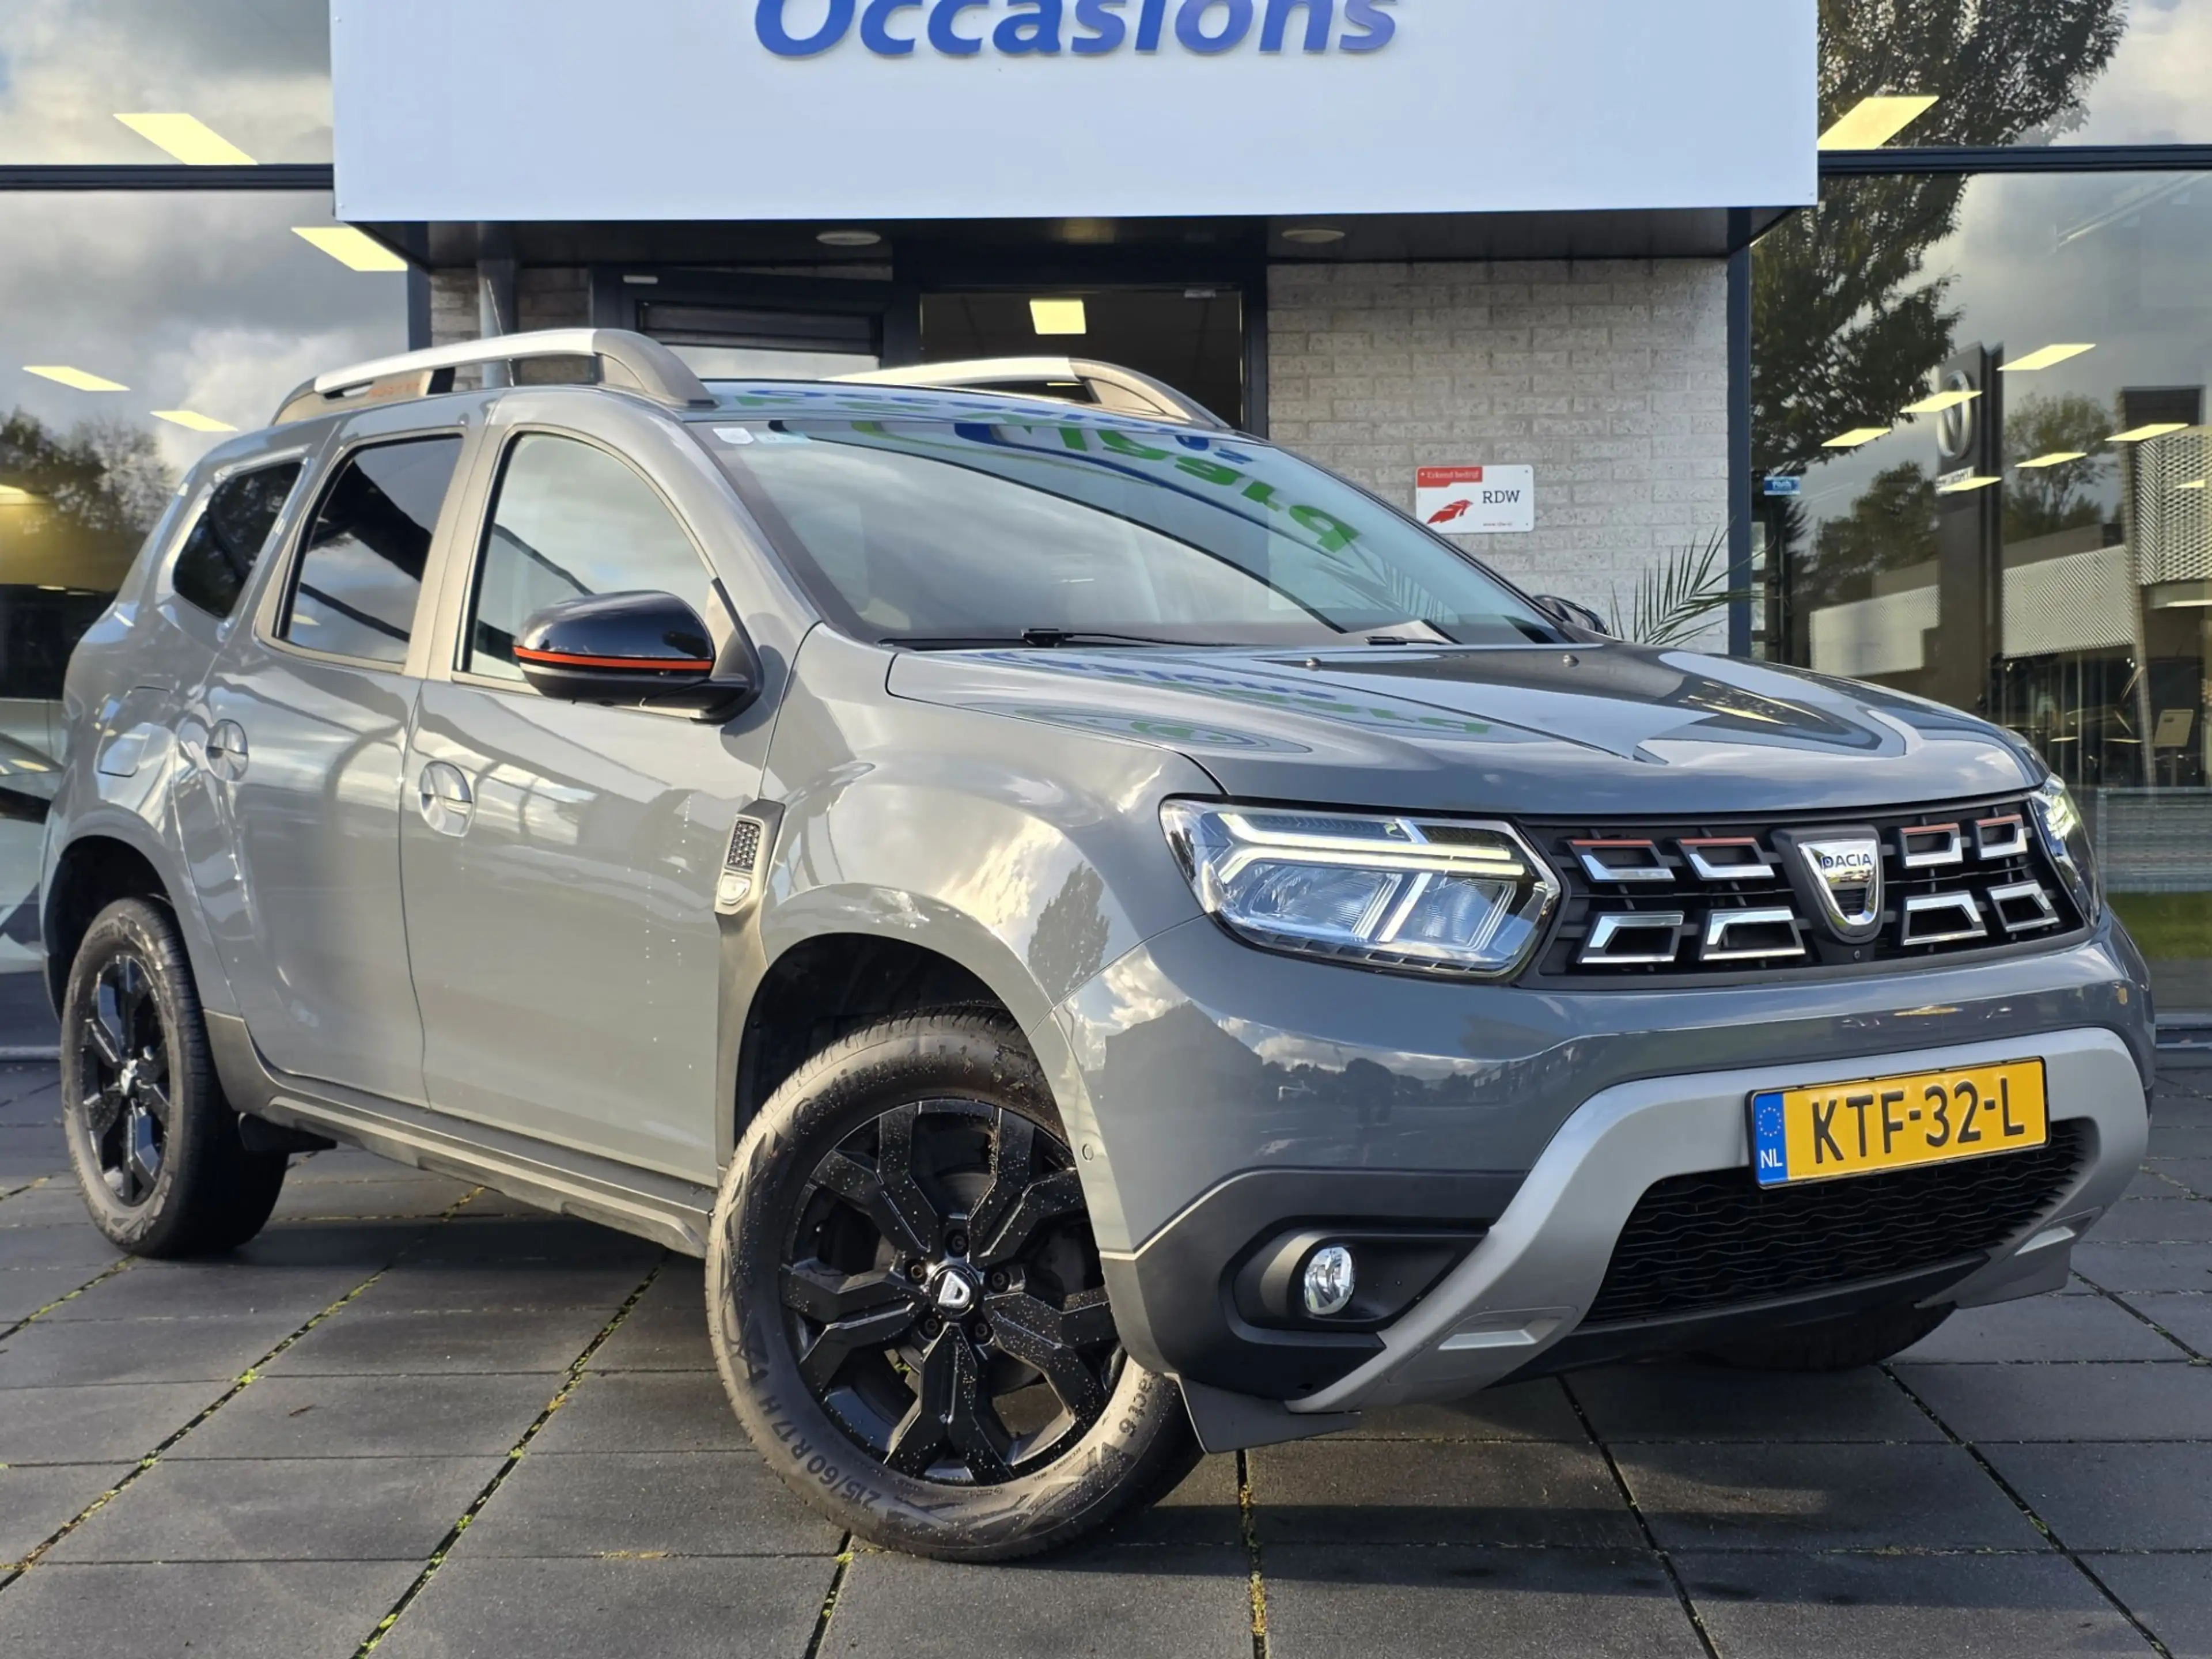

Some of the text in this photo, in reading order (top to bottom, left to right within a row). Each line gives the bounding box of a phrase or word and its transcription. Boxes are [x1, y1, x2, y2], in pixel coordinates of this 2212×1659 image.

[755, 0, 1396, 56] Occasions
[1483, 490, 1520, 503] RDW
[1821, 853, 1872, 869] DACIA
[1812, 1077, 2025, 1164] KTF-32-L
[1760, 1147, 1784, 1169] NL
[771, 1420, 797, 1442] 17
[791, 1438, 813, 1460] R
[807, 1455, 882, 1508] 215/60
